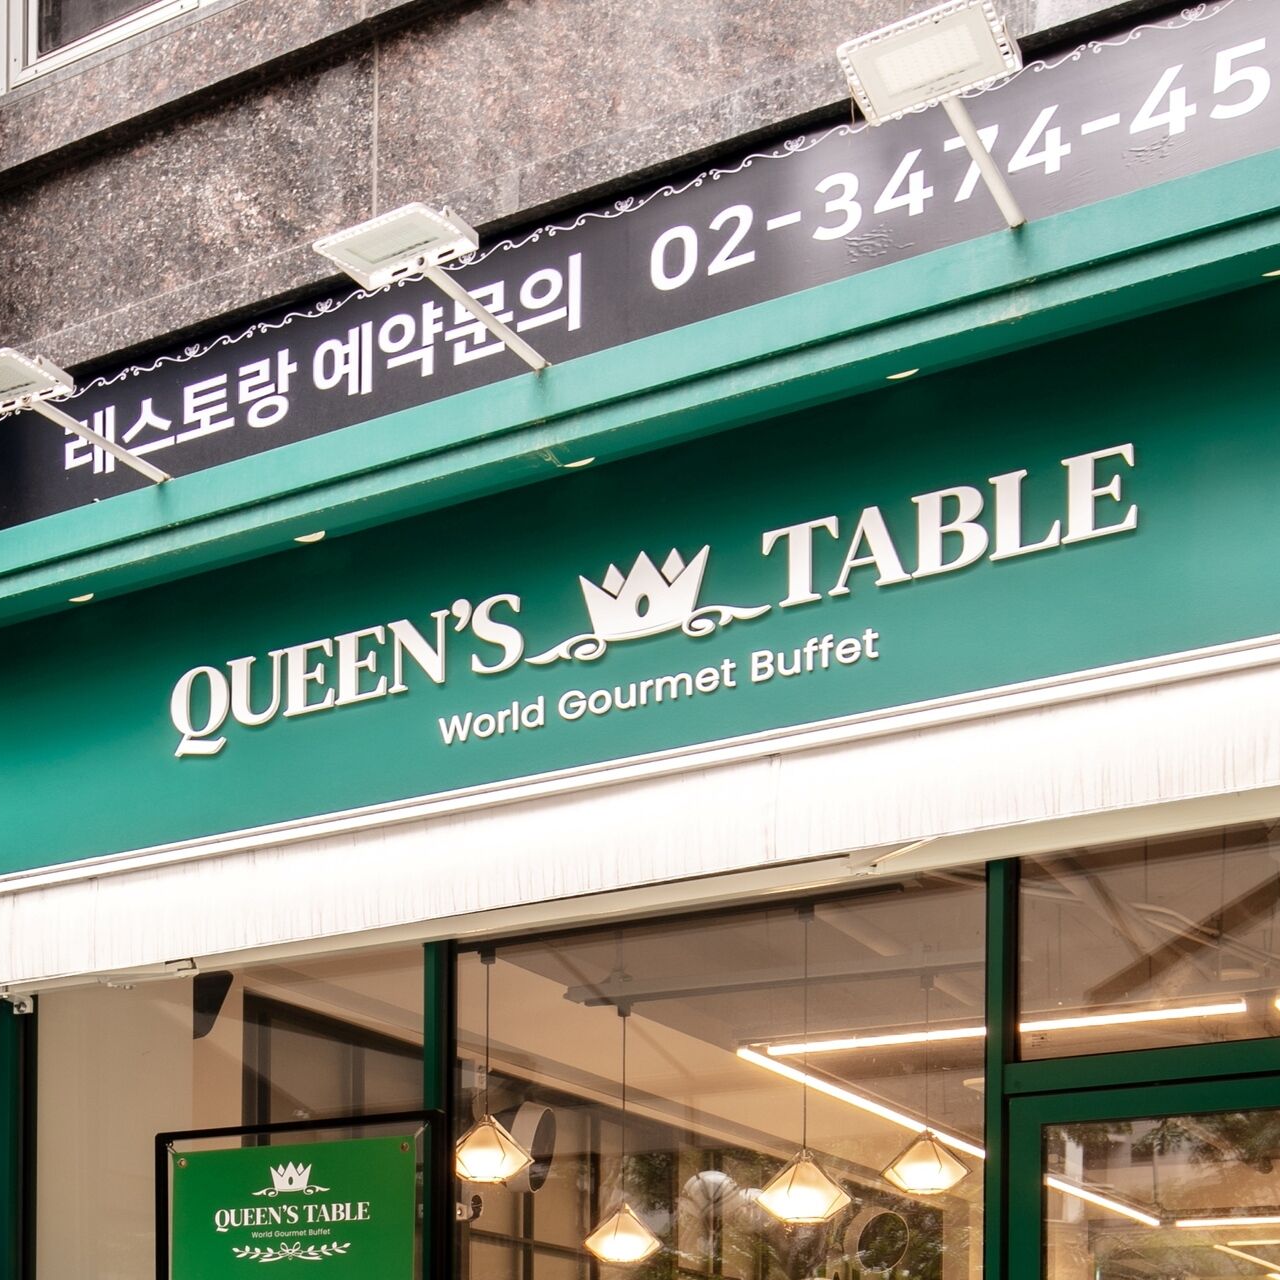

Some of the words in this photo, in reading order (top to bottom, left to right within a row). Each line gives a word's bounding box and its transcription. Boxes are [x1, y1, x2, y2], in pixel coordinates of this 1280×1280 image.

[64, 348, 297, 474] 레스토랑
[171, 593, 524, 757] QUEEN'S
[762, 443, 1137, 608] TABLE
[439, 695, 544, 745] World
[559, 658, 736, 721] Gourmet
[751, 628, 879, 682] Buffet
[214, 1204, 299, 1232] QUEEN'S
[303, 1202, 370, 1223] TABLE
[252, 1230, 273, 1238] World
[274, 1229, 307, 1237] Gourmet
[308, 1228, 331, 1236] Buffet
